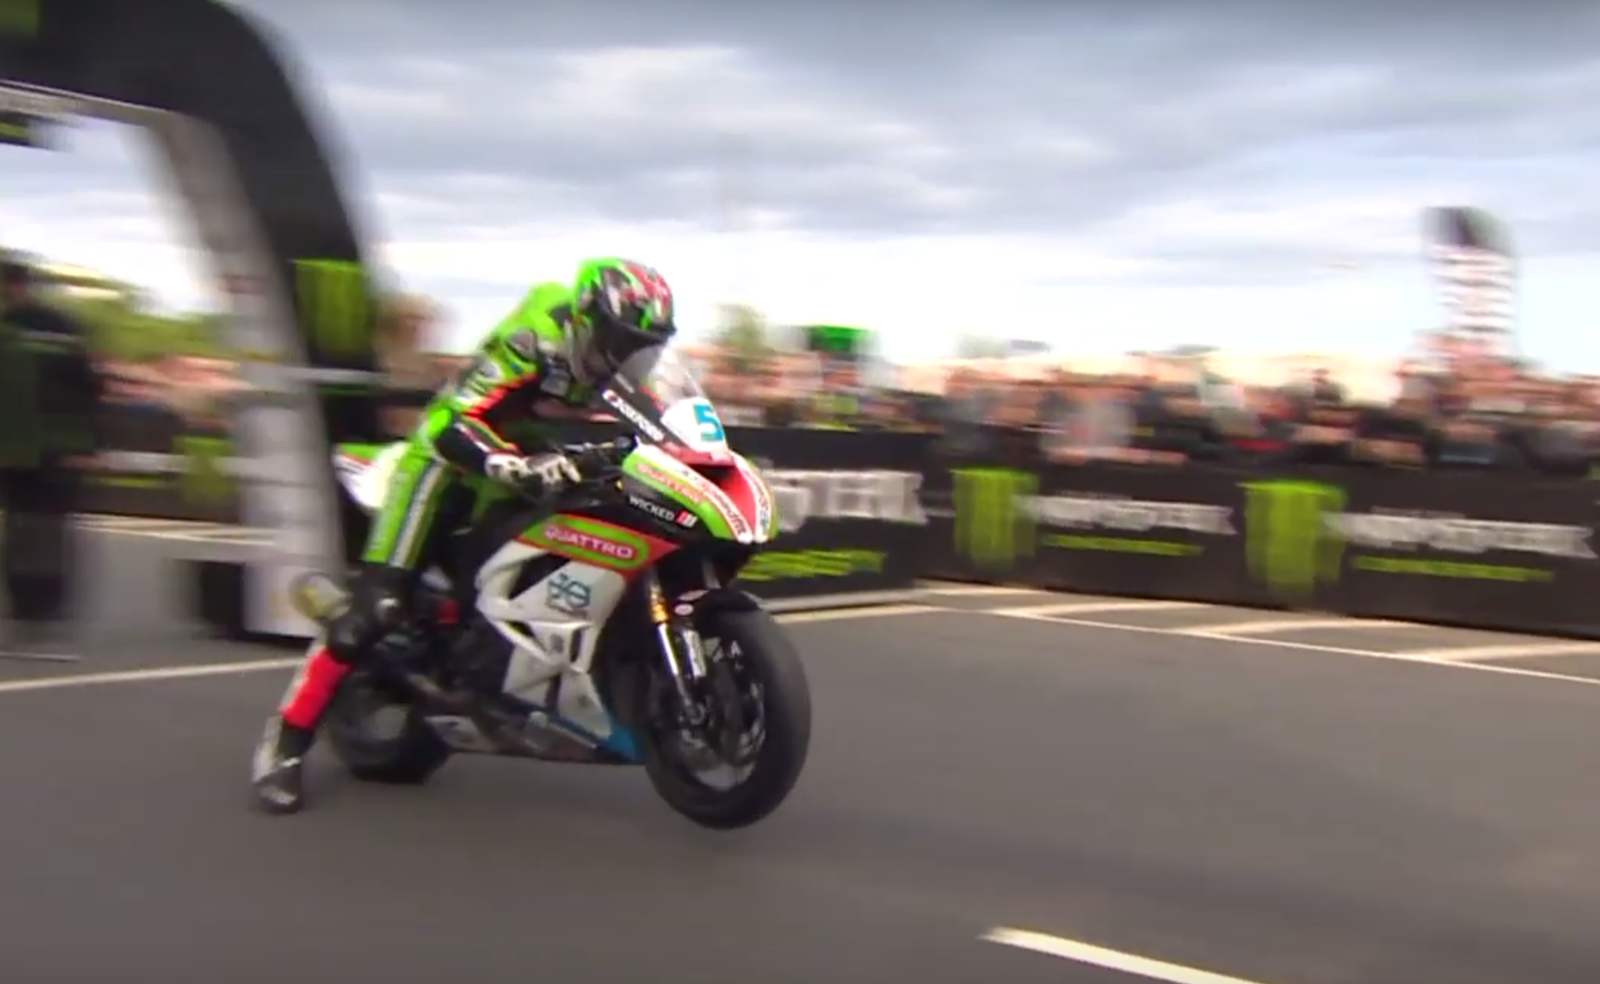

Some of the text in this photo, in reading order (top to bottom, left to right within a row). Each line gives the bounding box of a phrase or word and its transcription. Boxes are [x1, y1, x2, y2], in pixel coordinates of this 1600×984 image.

[694, 404, 725, 441] 5
[629, 495, 675, 521] WICKED
[543, 525, 634, 560] QUATTRO
